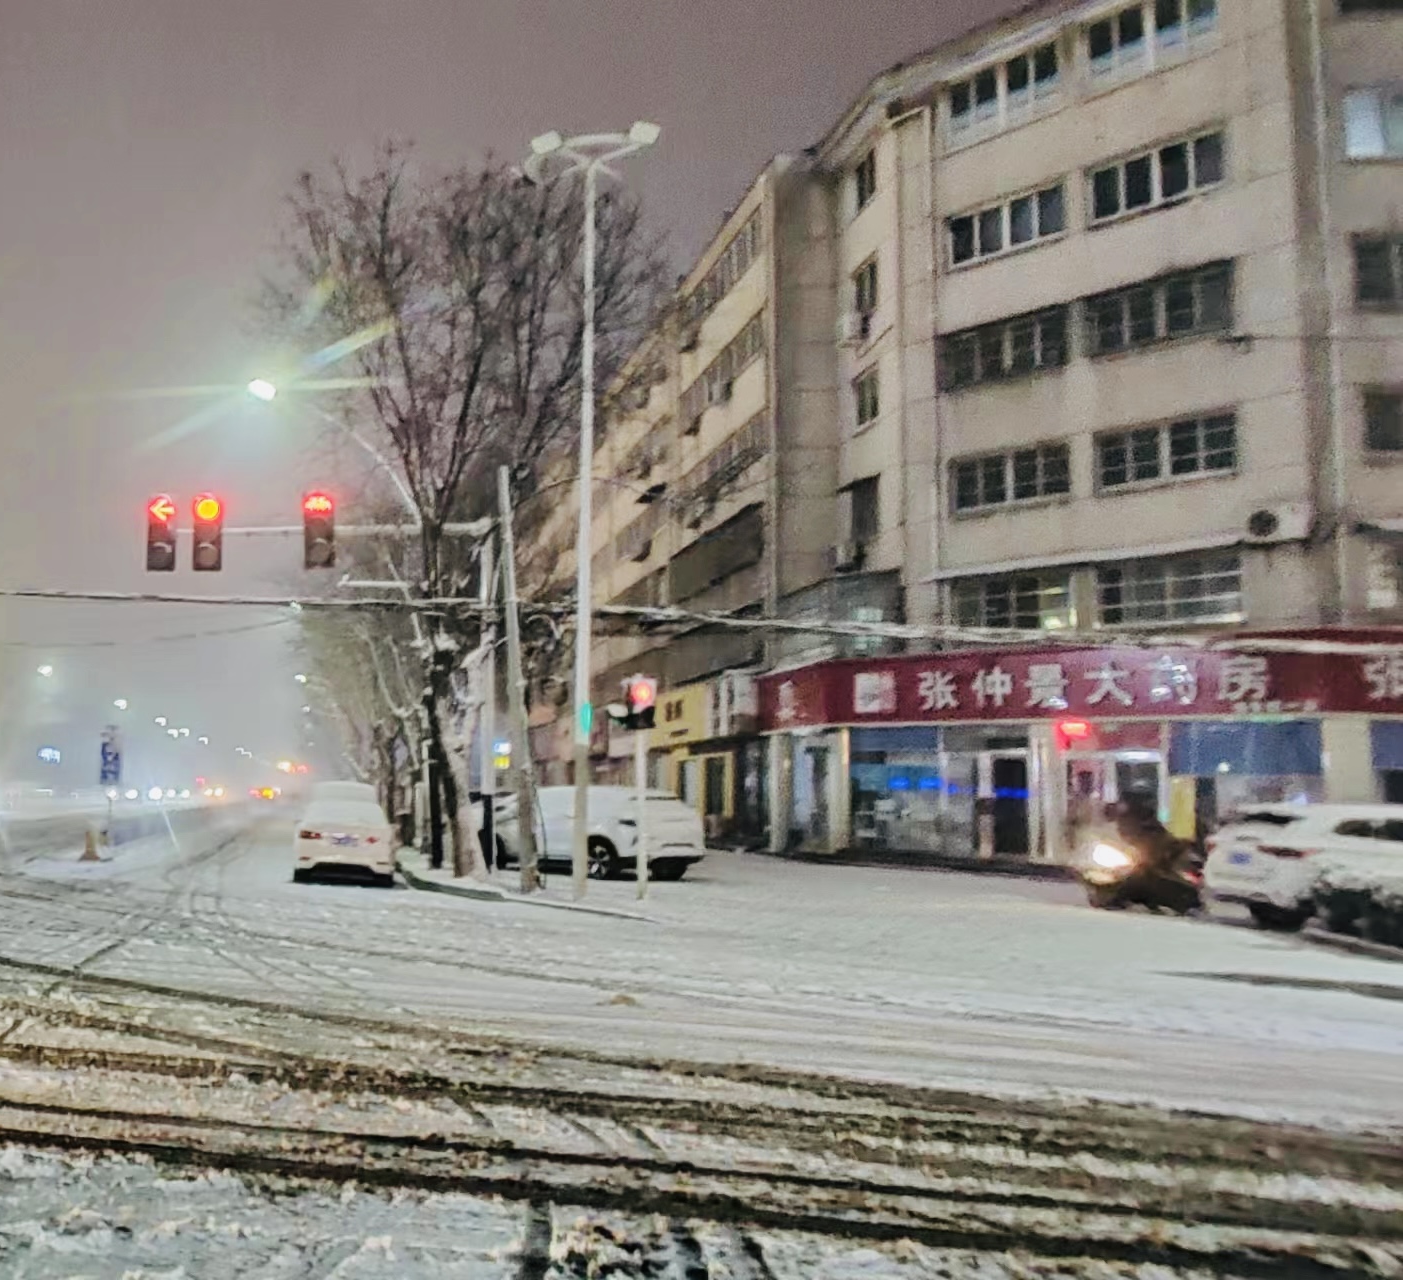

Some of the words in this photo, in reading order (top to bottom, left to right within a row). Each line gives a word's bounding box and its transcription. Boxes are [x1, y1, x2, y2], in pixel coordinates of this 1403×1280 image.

[917, 654, 1269, 711] 张仲景大药房
